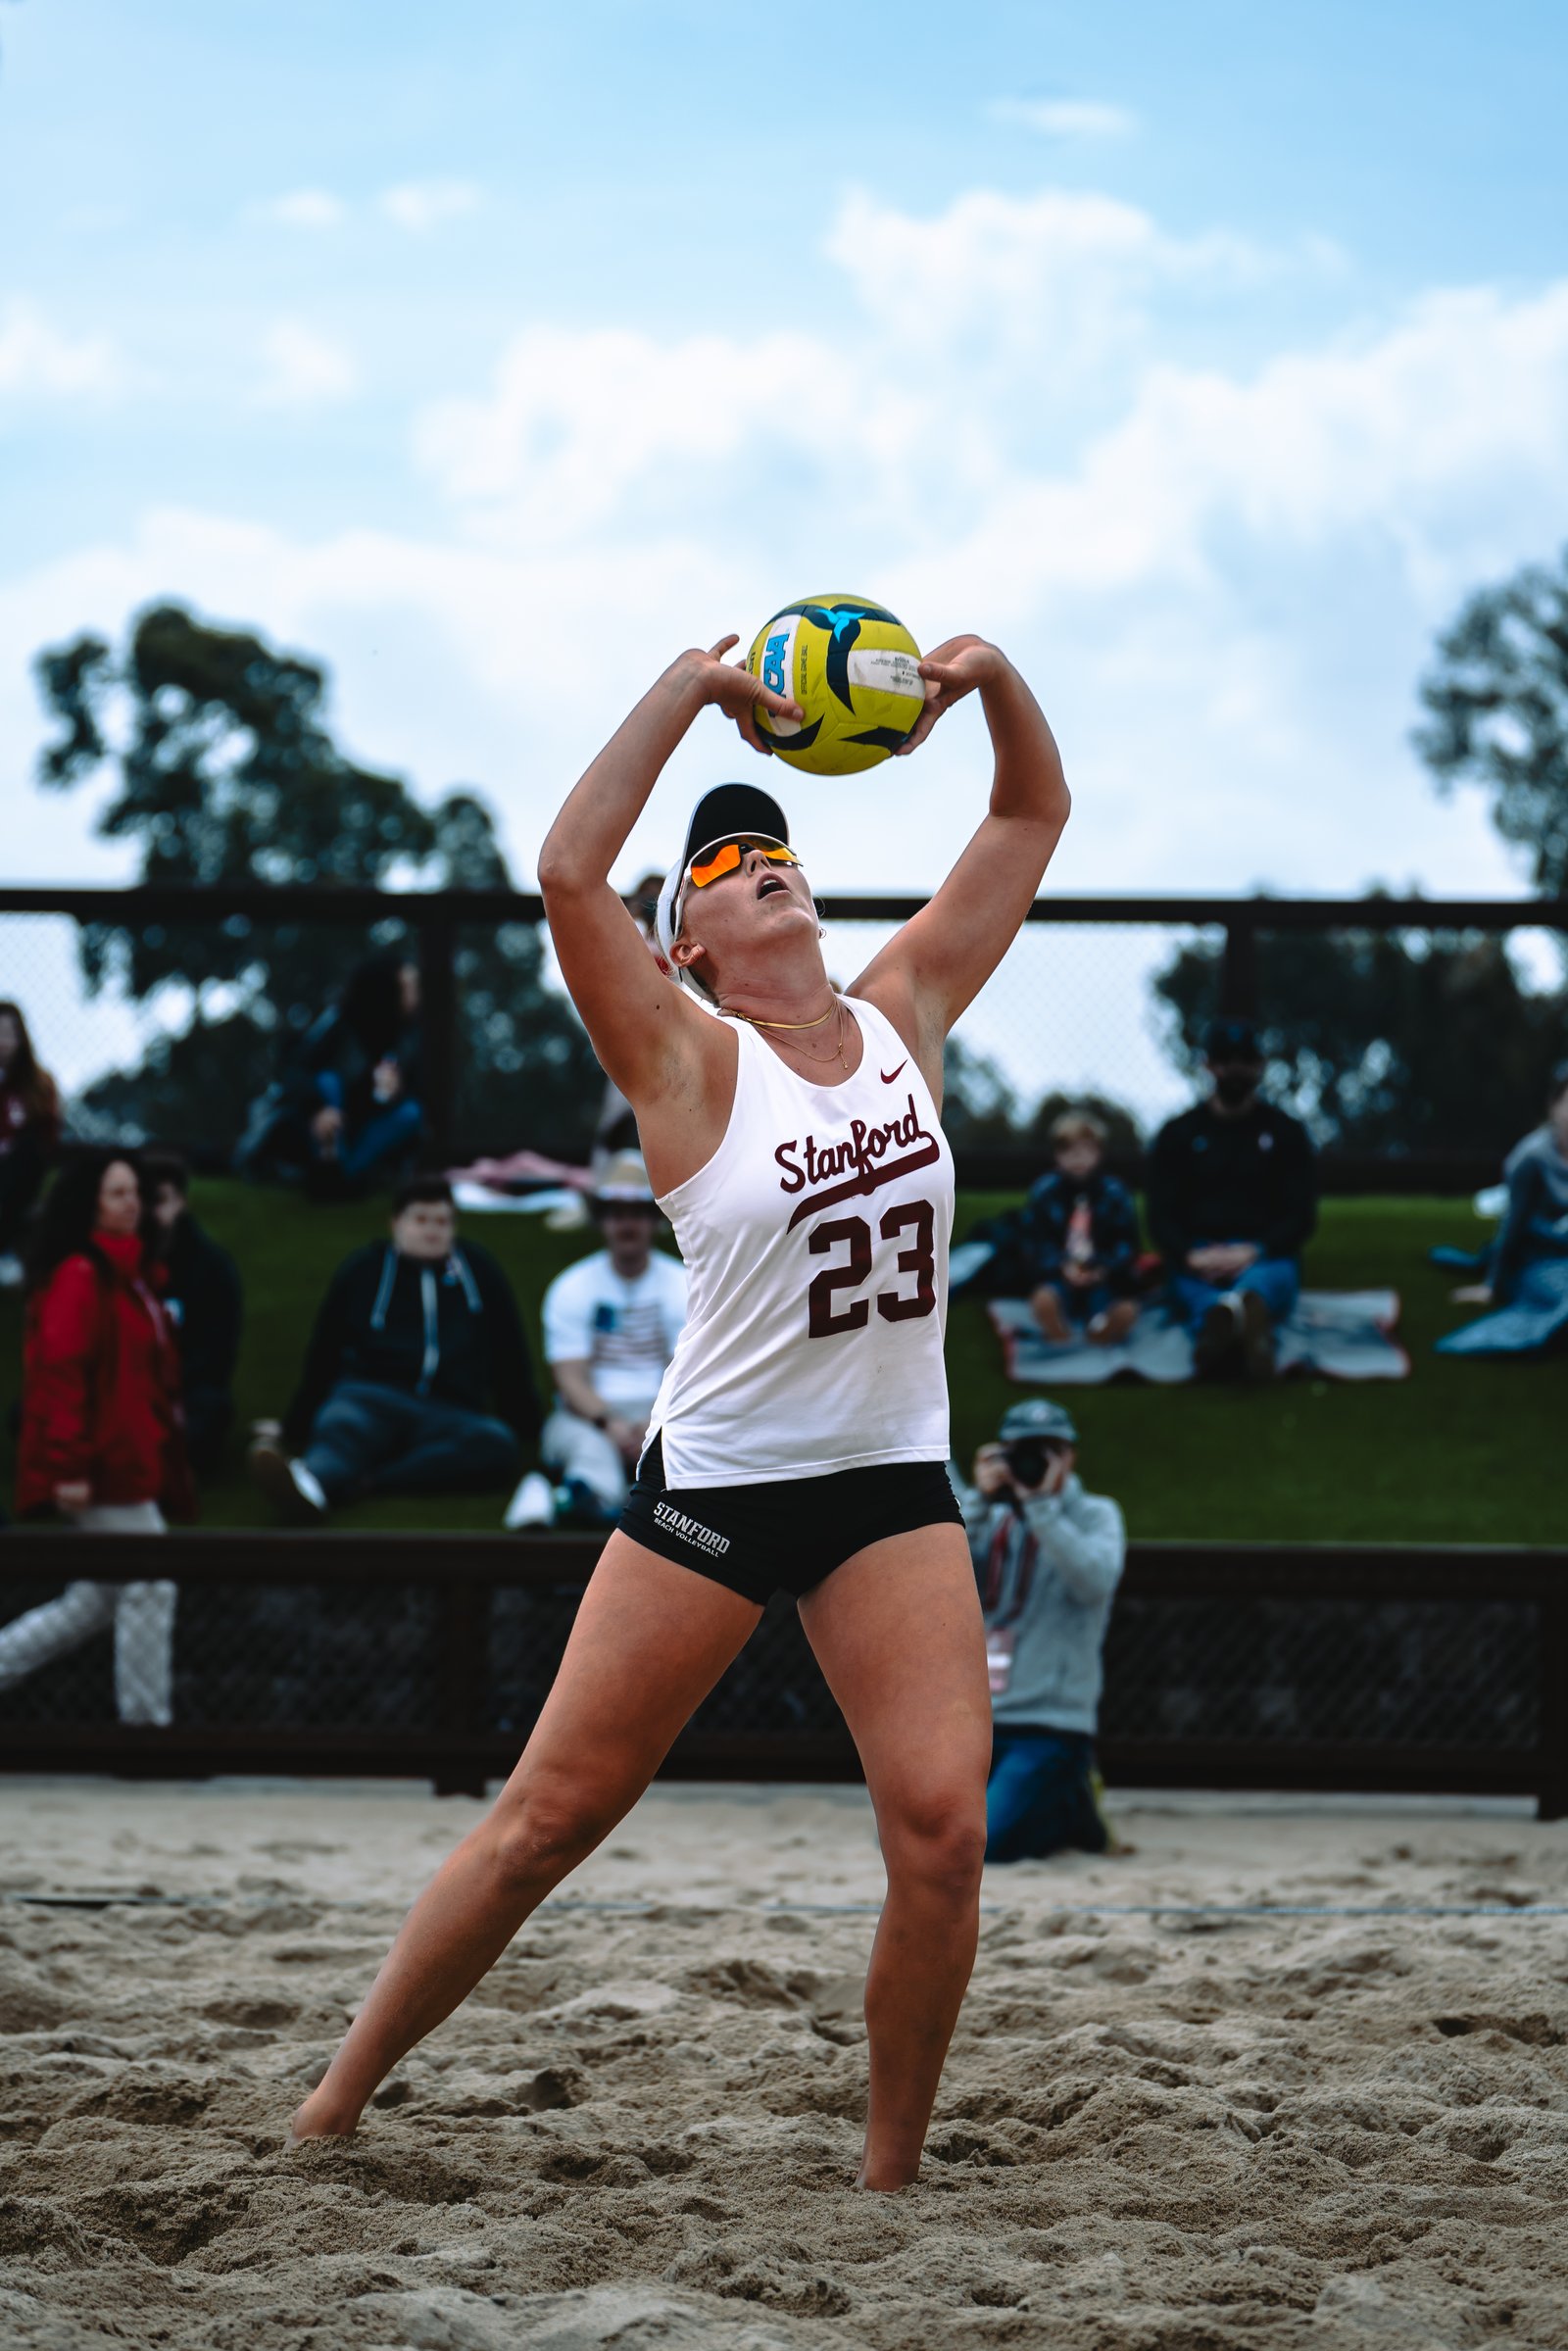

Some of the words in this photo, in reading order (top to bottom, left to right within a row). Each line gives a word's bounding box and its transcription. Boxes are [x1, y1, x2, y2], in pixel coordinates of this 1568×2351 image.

[763, 632, 790, 717] CAA
[775, 1093, 940, 1200] Stanford
[808, 1199, 937, 1339] 23
[653, 1501, 731, 1554] STANFORD
[654, 1517, 675, 1534] BEACH
[675, 1530, 719, 1558] VOLLEYBALL
